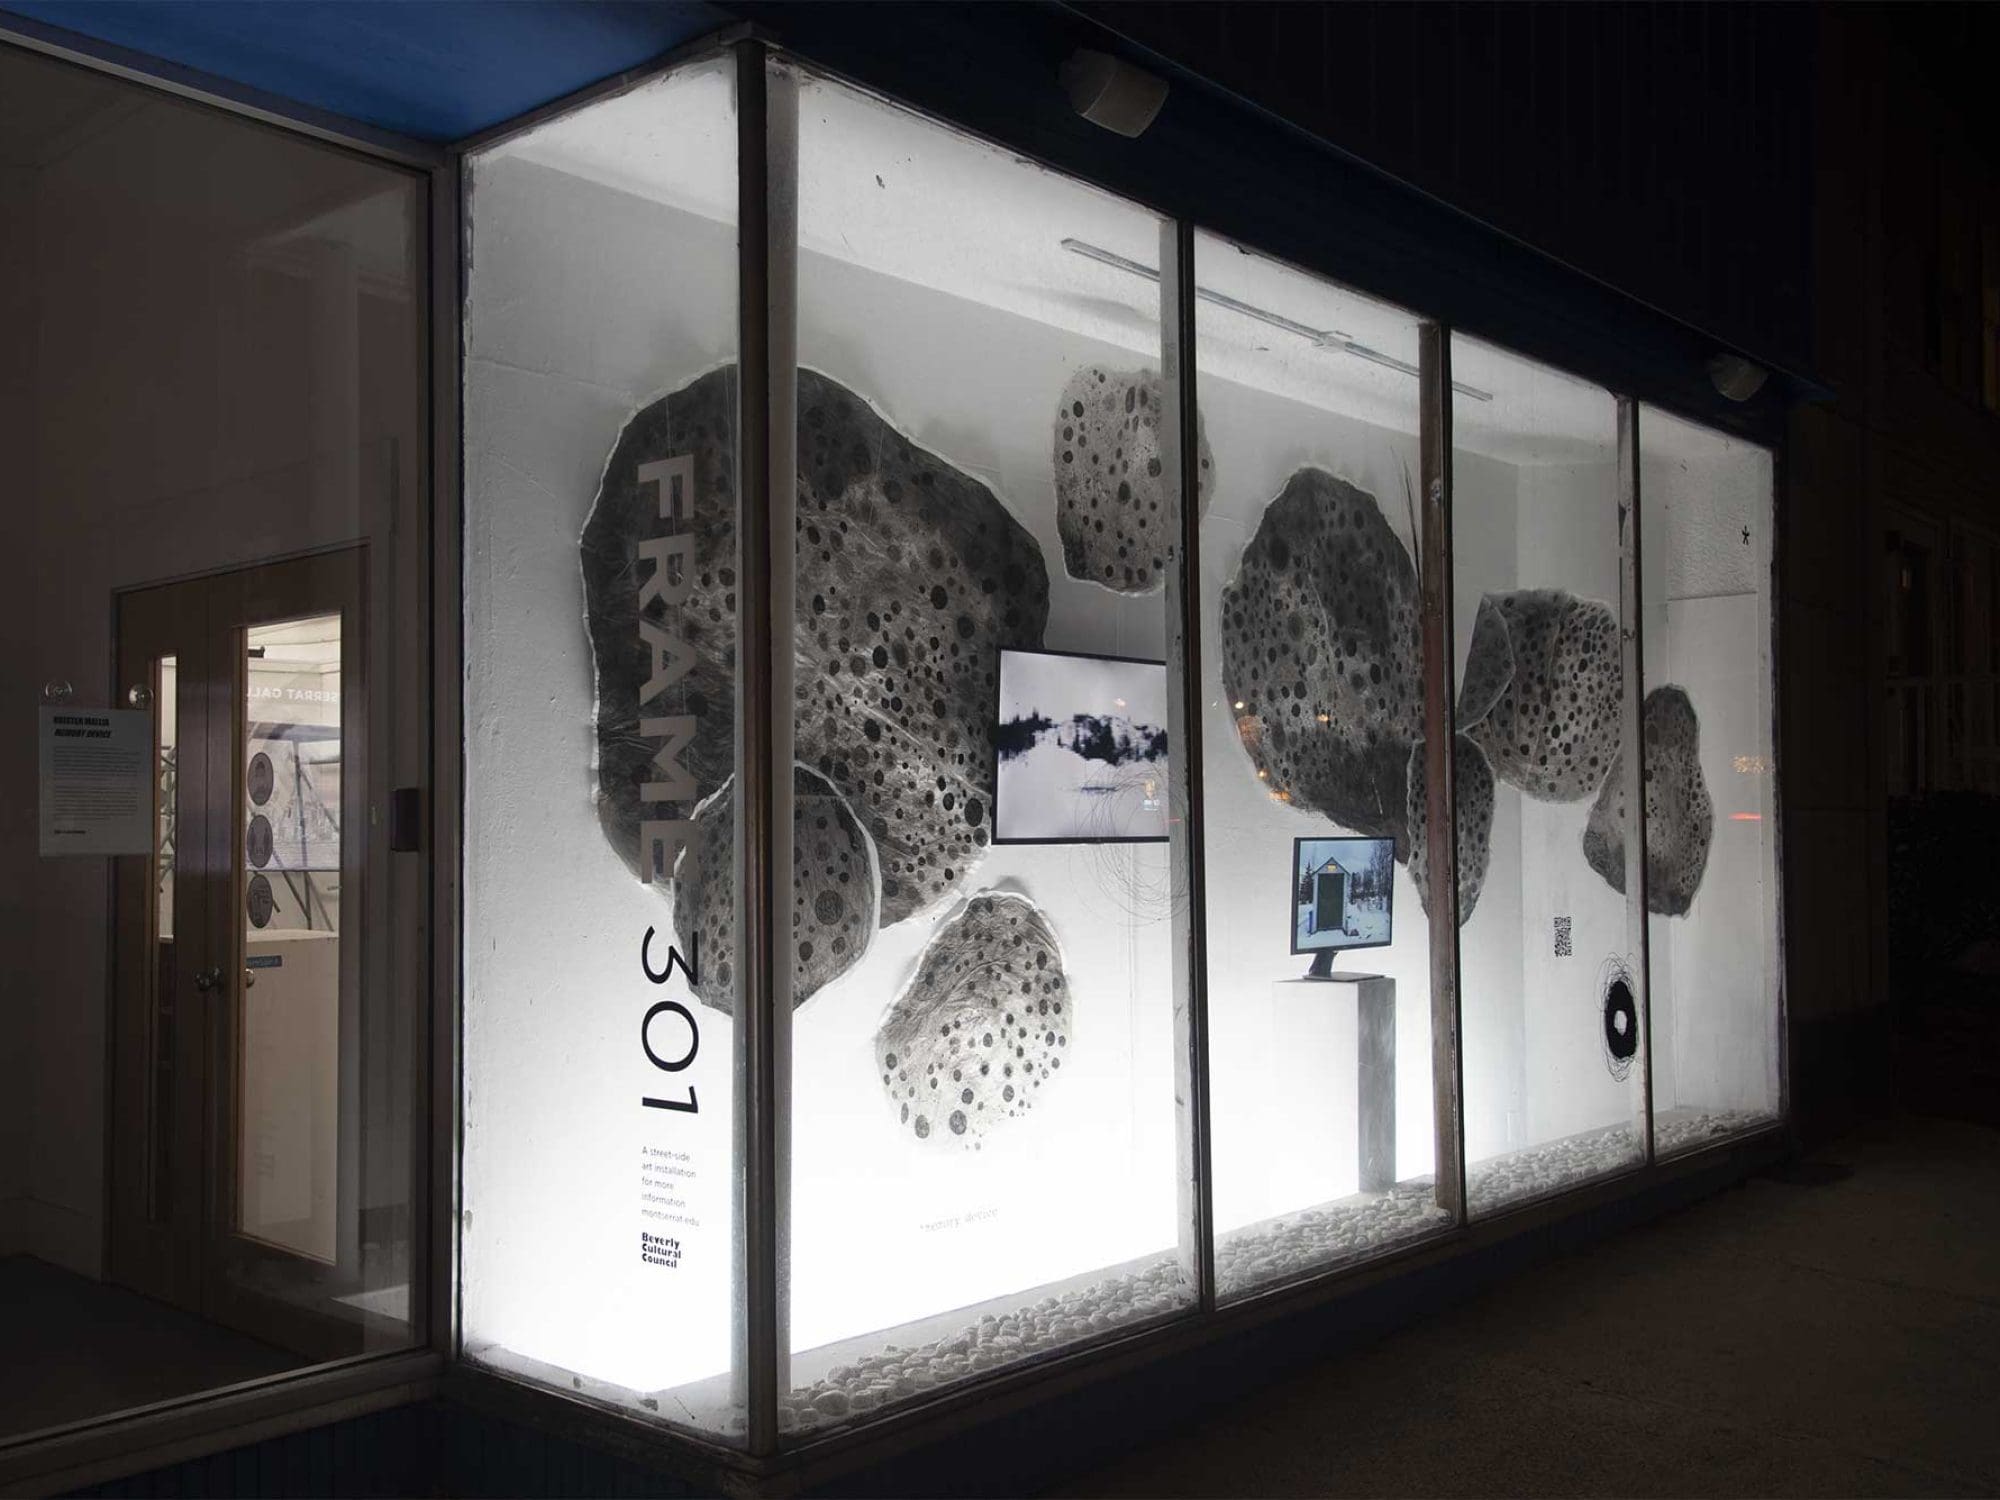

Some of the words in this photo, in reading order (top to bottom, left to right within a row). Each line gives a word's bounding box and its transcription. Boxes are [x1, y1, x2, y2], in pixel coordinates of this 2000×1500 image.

[637, 453, 698, 884] FRAME
[54, 728, 87, 738] MEMORY
[86, 729, 112, 739] DEVICE
[641, 925, 699, 1115] 301
[642, 1146, 648, 1155] A
[650, 1148, 690, 1162] street-side
[641, 1162, 652, 1171] art
[654, 1163, 696, 1178] installation
[641, 1175, 653, 1186] for
[654, 1180, 674, 1190] more
[641, 1192, 686, 1208] information
[641, 1232, 680, 1250] Beverly
[641, 1242, 682, 1259] Cultural
[641, 1252, 678, 1269] Council
